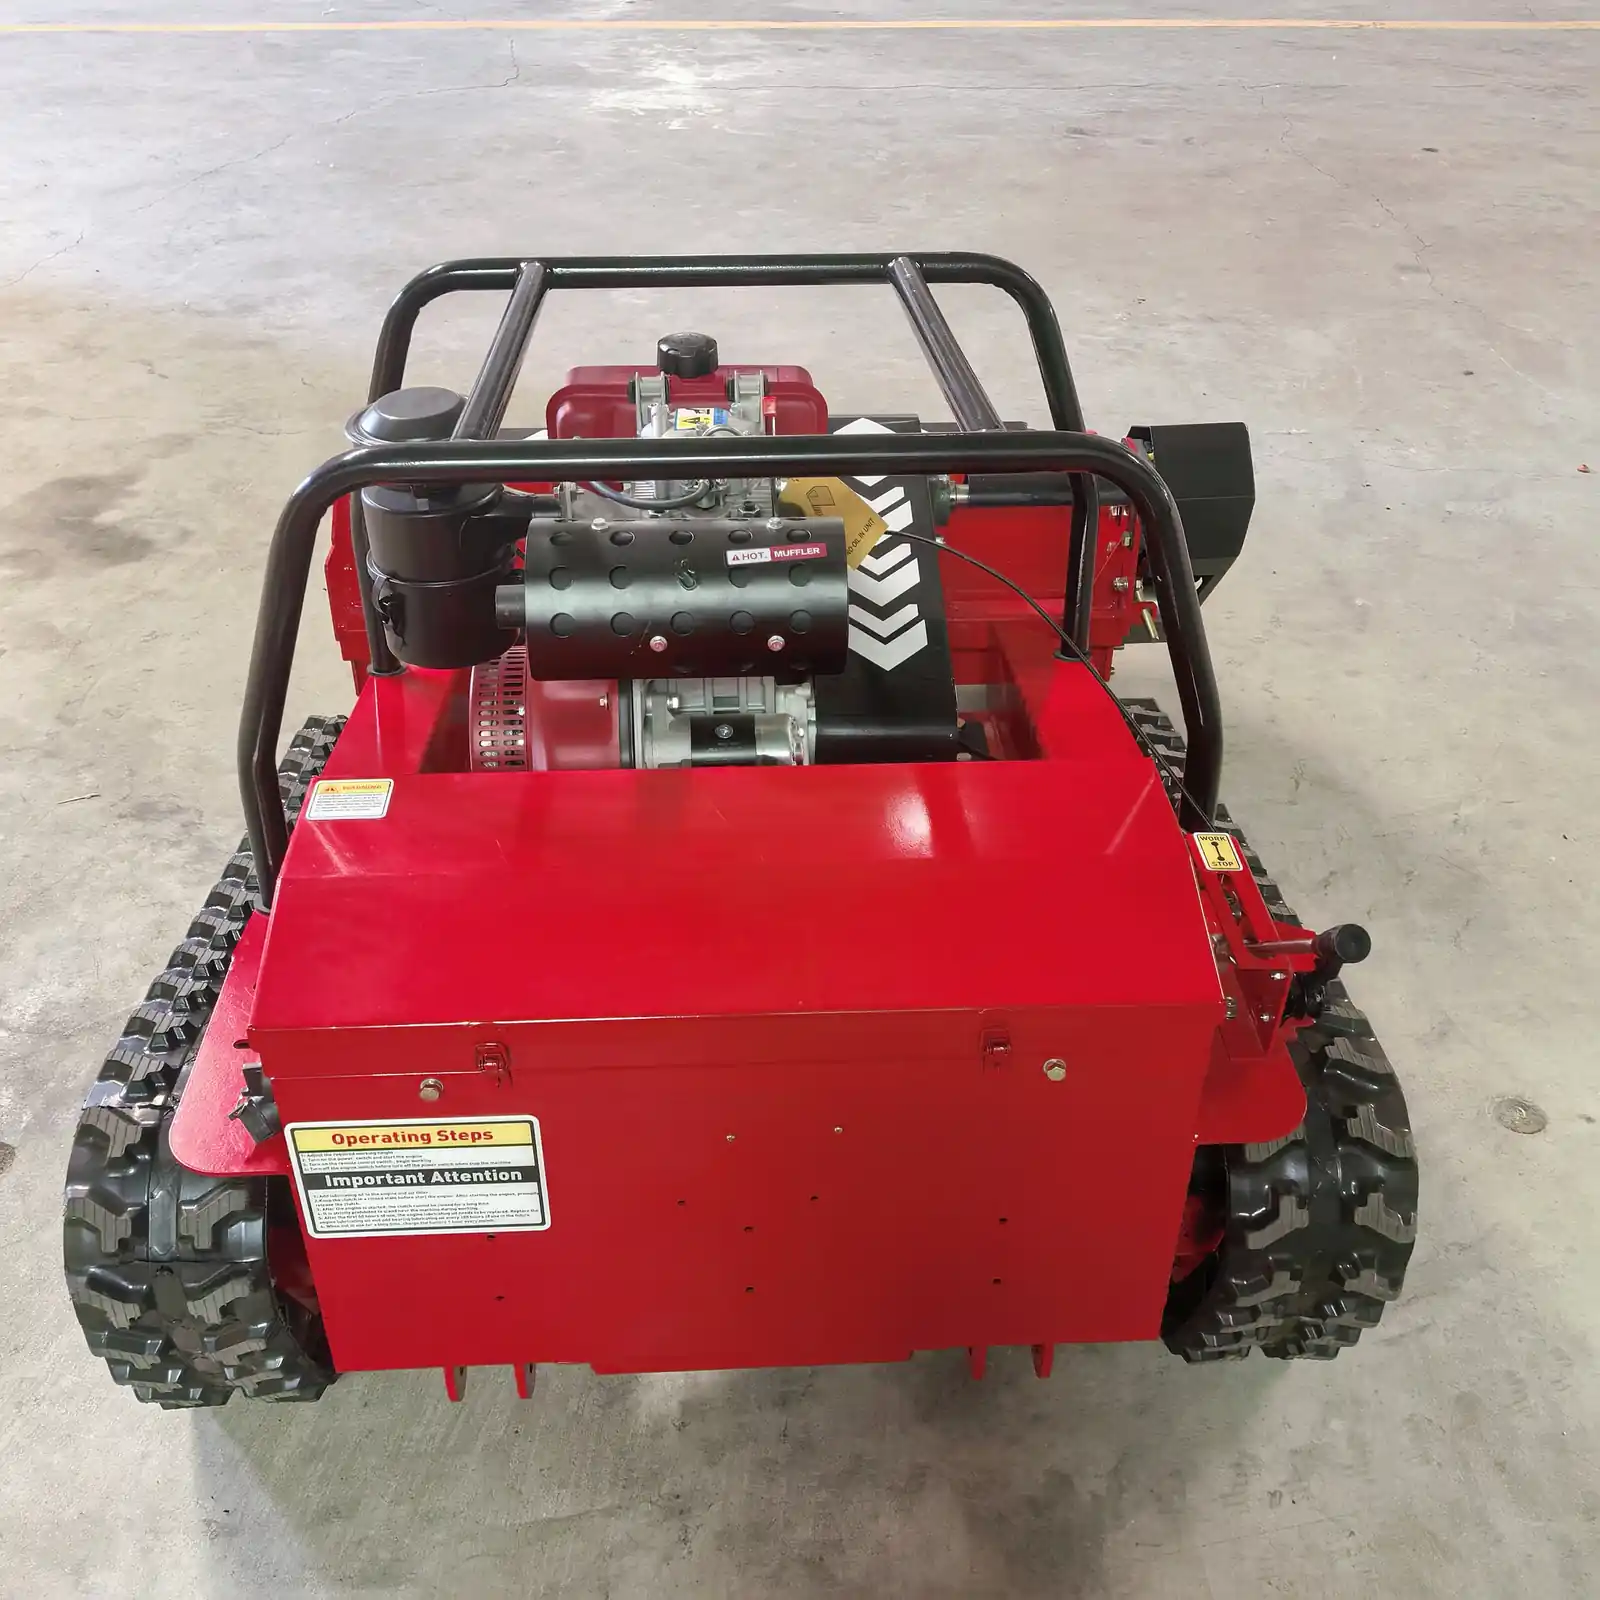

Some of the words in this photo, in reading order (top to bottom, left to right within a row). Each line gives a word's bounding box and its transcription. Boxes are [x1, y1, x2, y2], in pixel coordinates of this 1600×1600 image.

[774, 547, 820, 558] MUFFLER
[331, 1130, 431, 1147] Operating
[437, 1128, 493, 1143] Steps
[325, 1172, 425, 1188] Important
[430, 1169, 521, 1183] Attention
